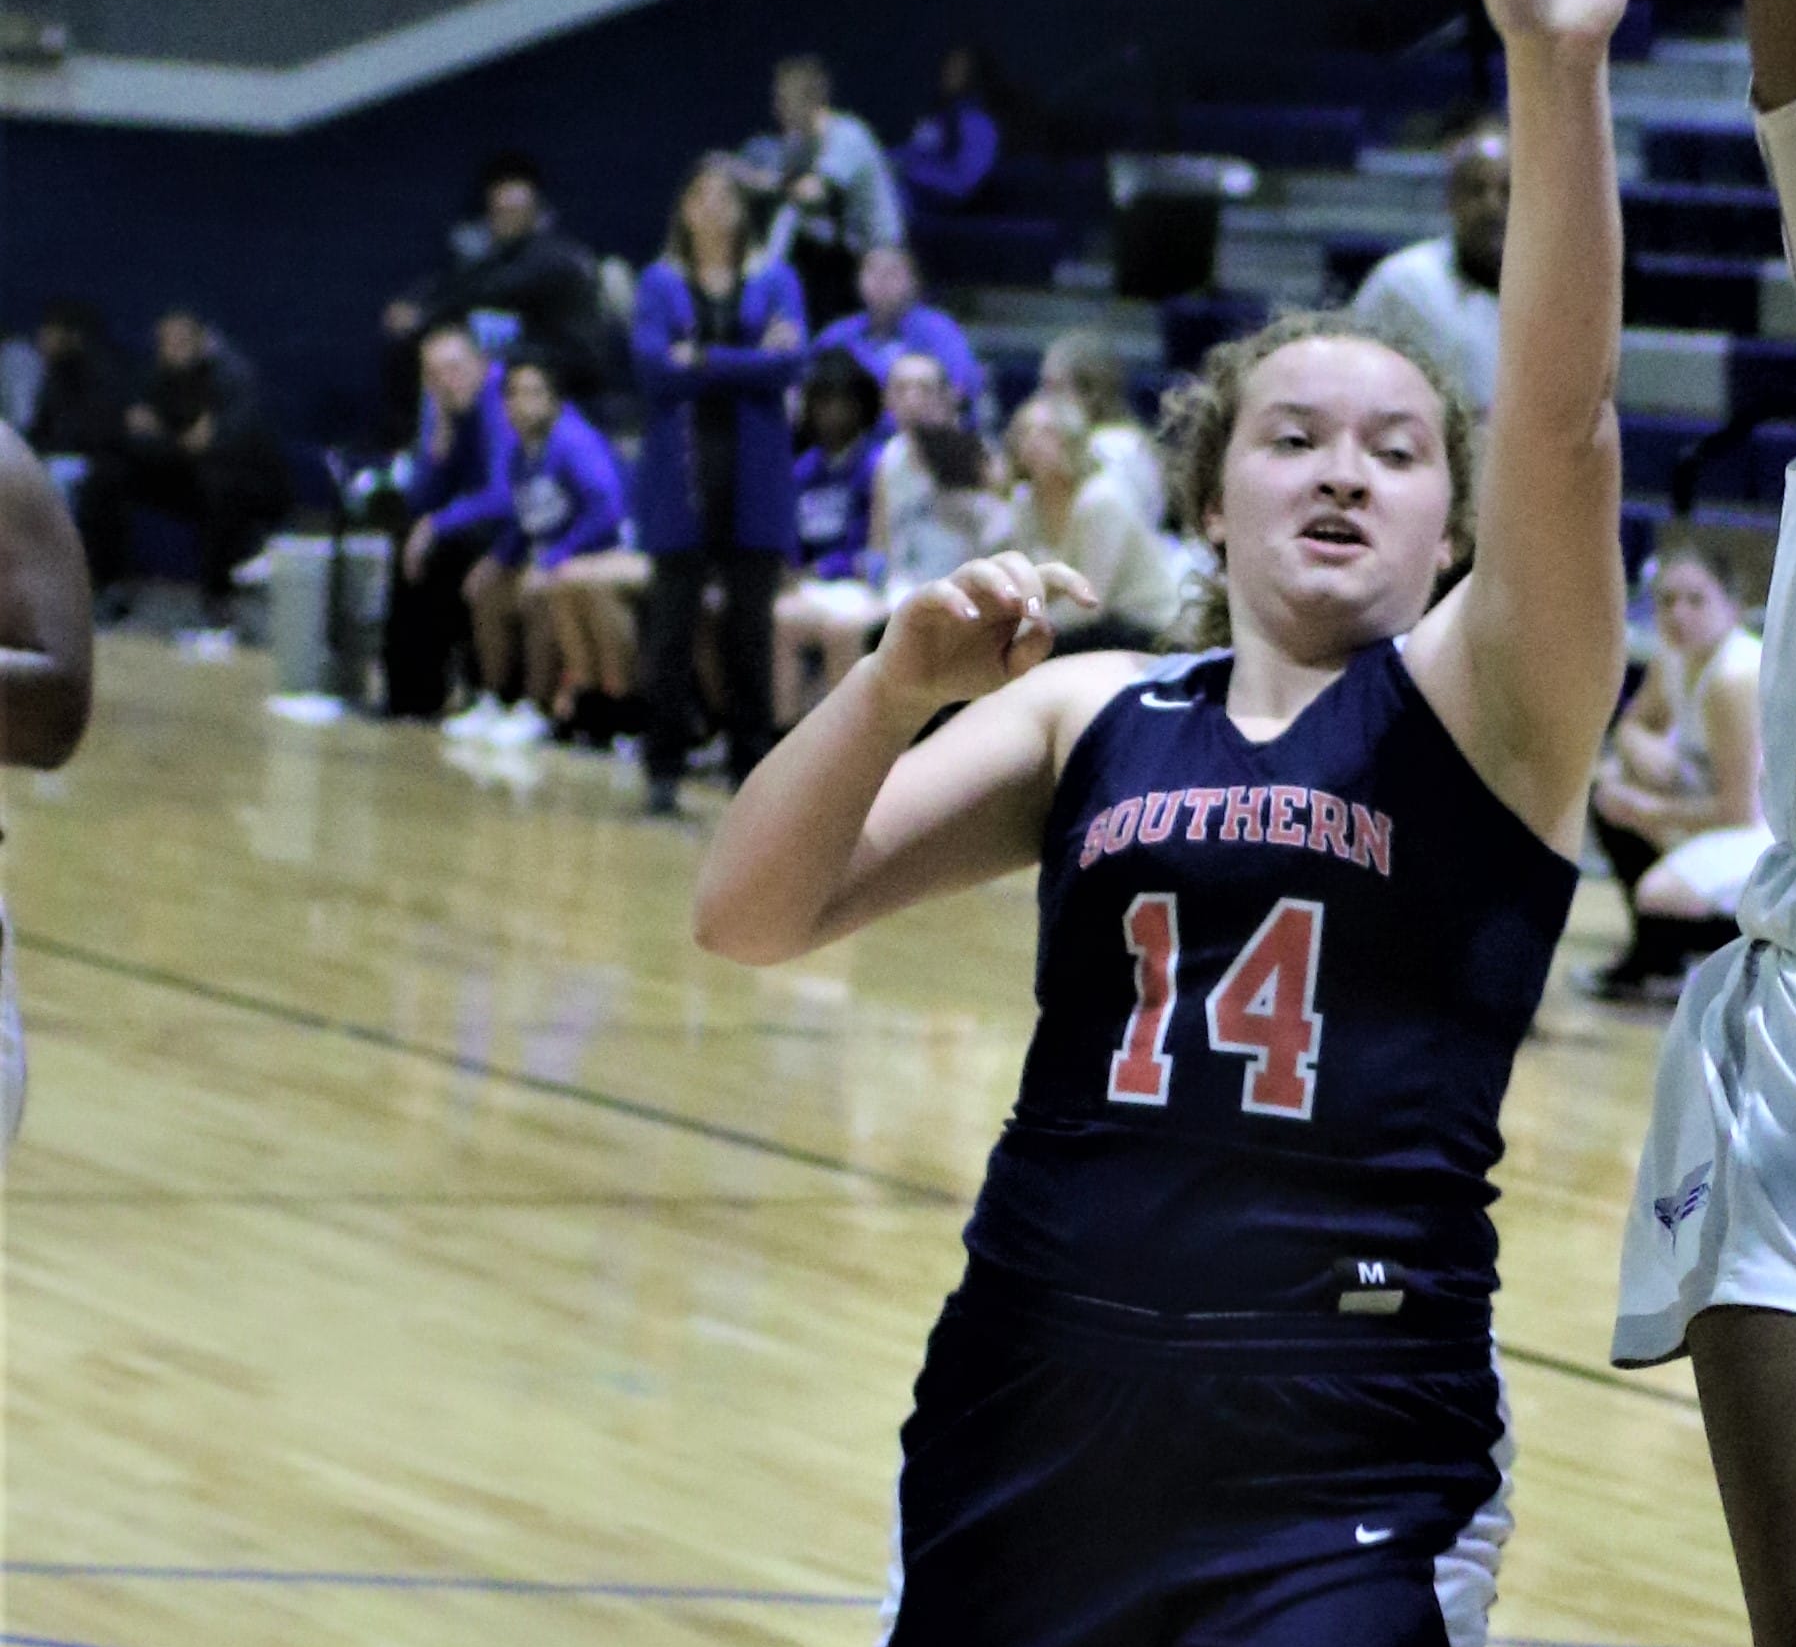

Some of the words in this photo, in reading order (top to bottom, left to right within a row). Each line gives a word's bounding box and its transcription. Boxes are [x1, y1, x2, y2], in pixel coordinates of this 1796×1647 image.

[1078, 785, 1392, 878] SOUTHERN
[1107, 891, 1324, 1122] 14
[1357, 1261, 1386, 1285] M
